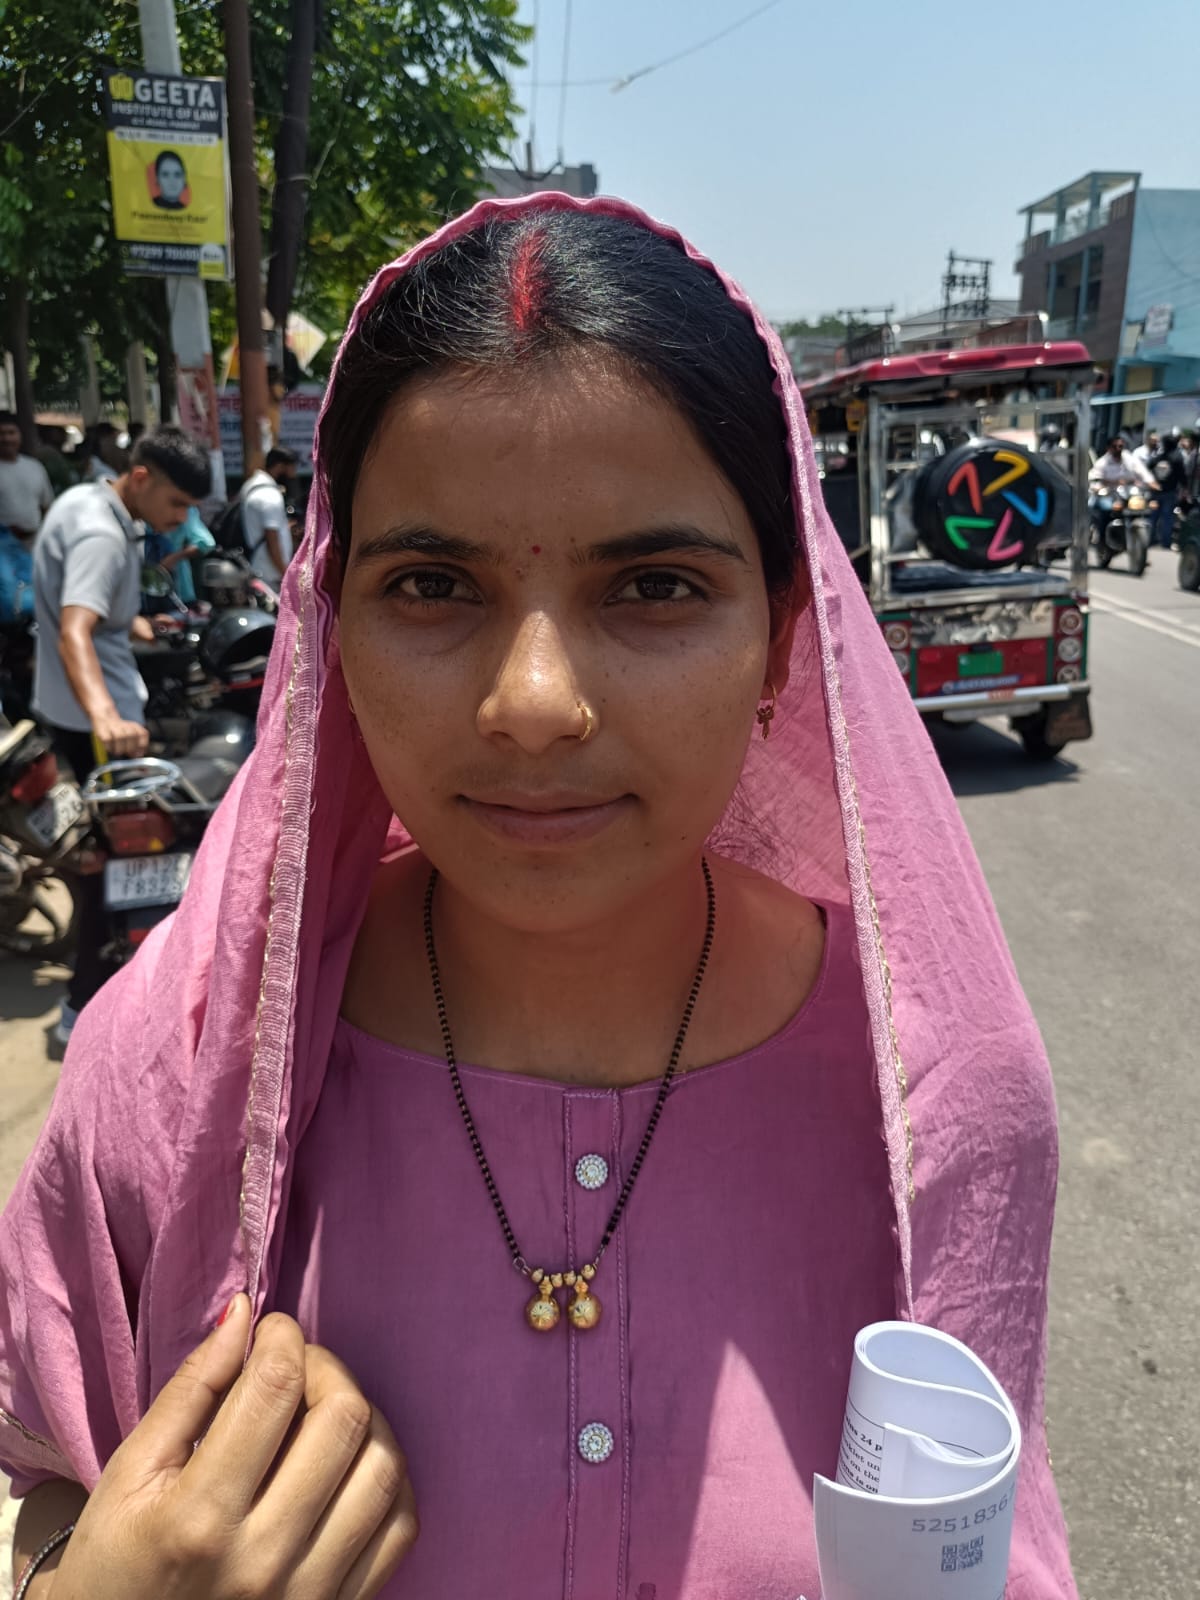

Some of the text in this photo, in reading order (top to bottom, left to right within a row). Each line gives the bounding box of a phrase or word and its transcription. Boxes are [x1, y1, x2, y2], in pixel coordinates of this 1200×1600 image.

[134, 78, 216, 109] GEETA
[860, 1433, 872, 1446] 24
[863, 1469, 880, 1483] the
